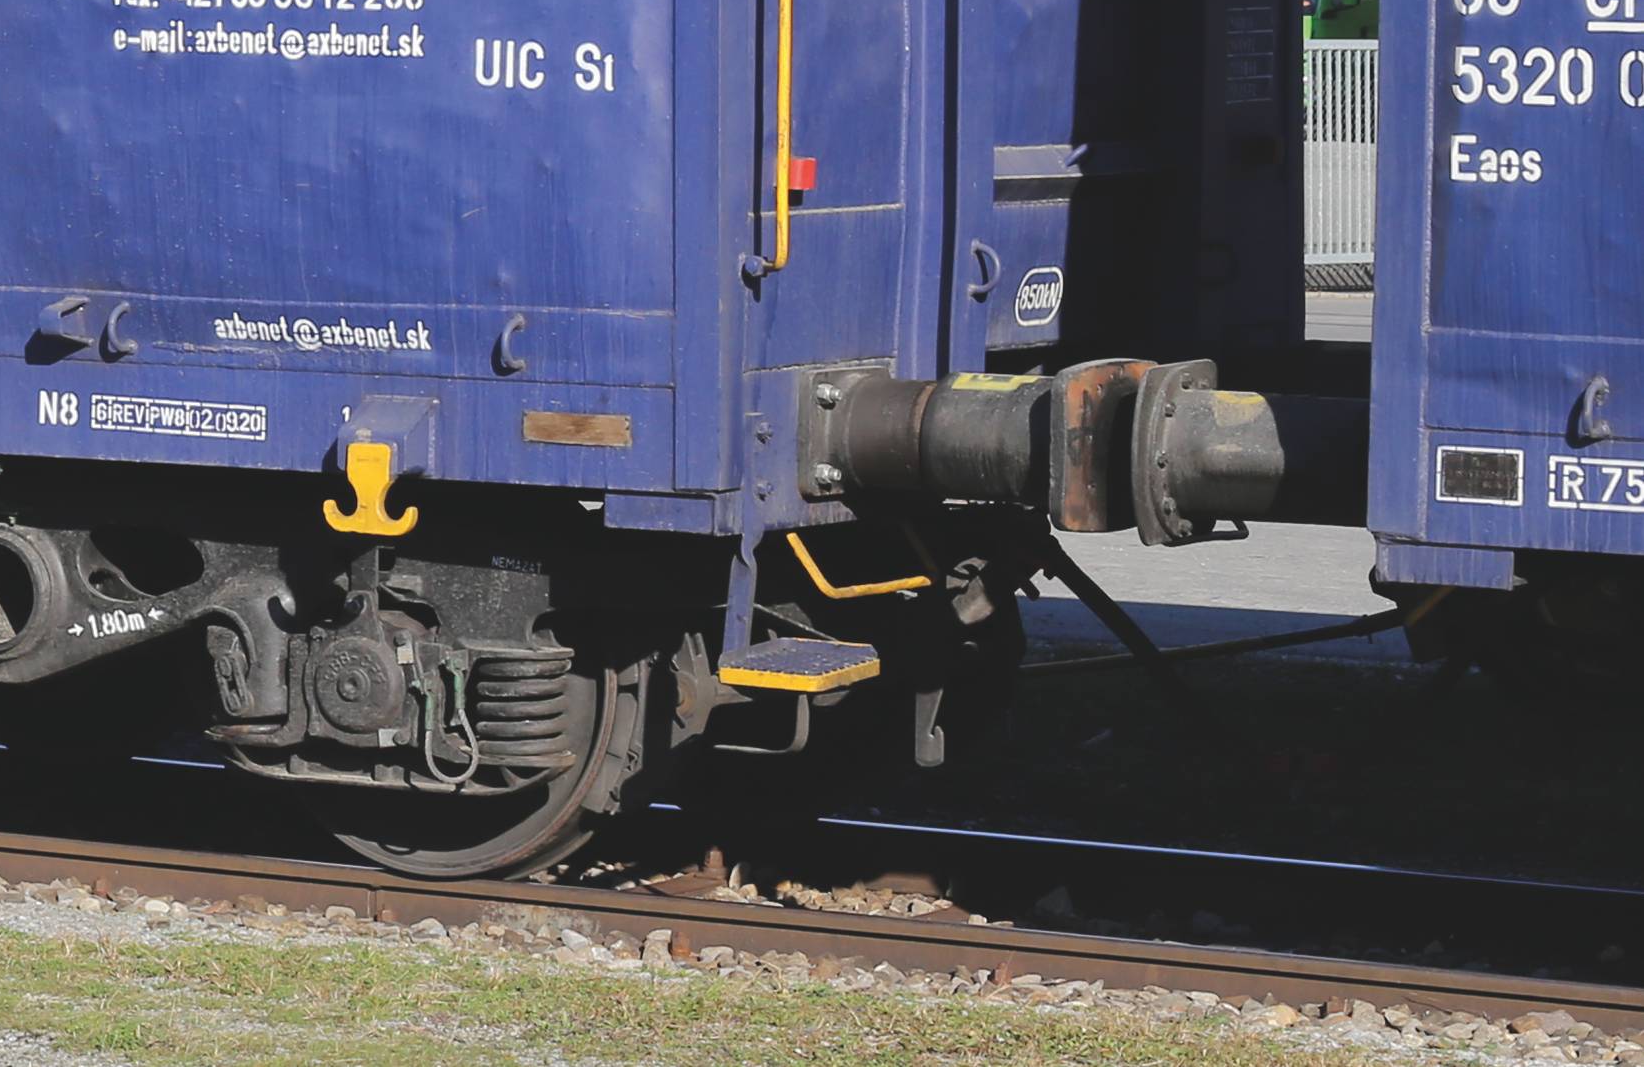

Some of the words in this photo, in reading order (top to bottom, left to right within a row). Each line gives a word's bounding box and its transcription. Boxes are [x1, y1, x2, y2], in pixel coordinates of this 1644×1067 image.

[473, 39, 545, 90] UIC
[1452, 46, 1595, 107] 5320
[1449, 135, 1543, 183] Eaos
[39, 390, 78, 426] N8
[112, 404, 144, 424] REV
[150, 406, 185, 427] PW8
[1562, 465, 1584, 500] R
[1601, 467, 1644, 504] 75
[88, 609, 146, 638] 1.80m
